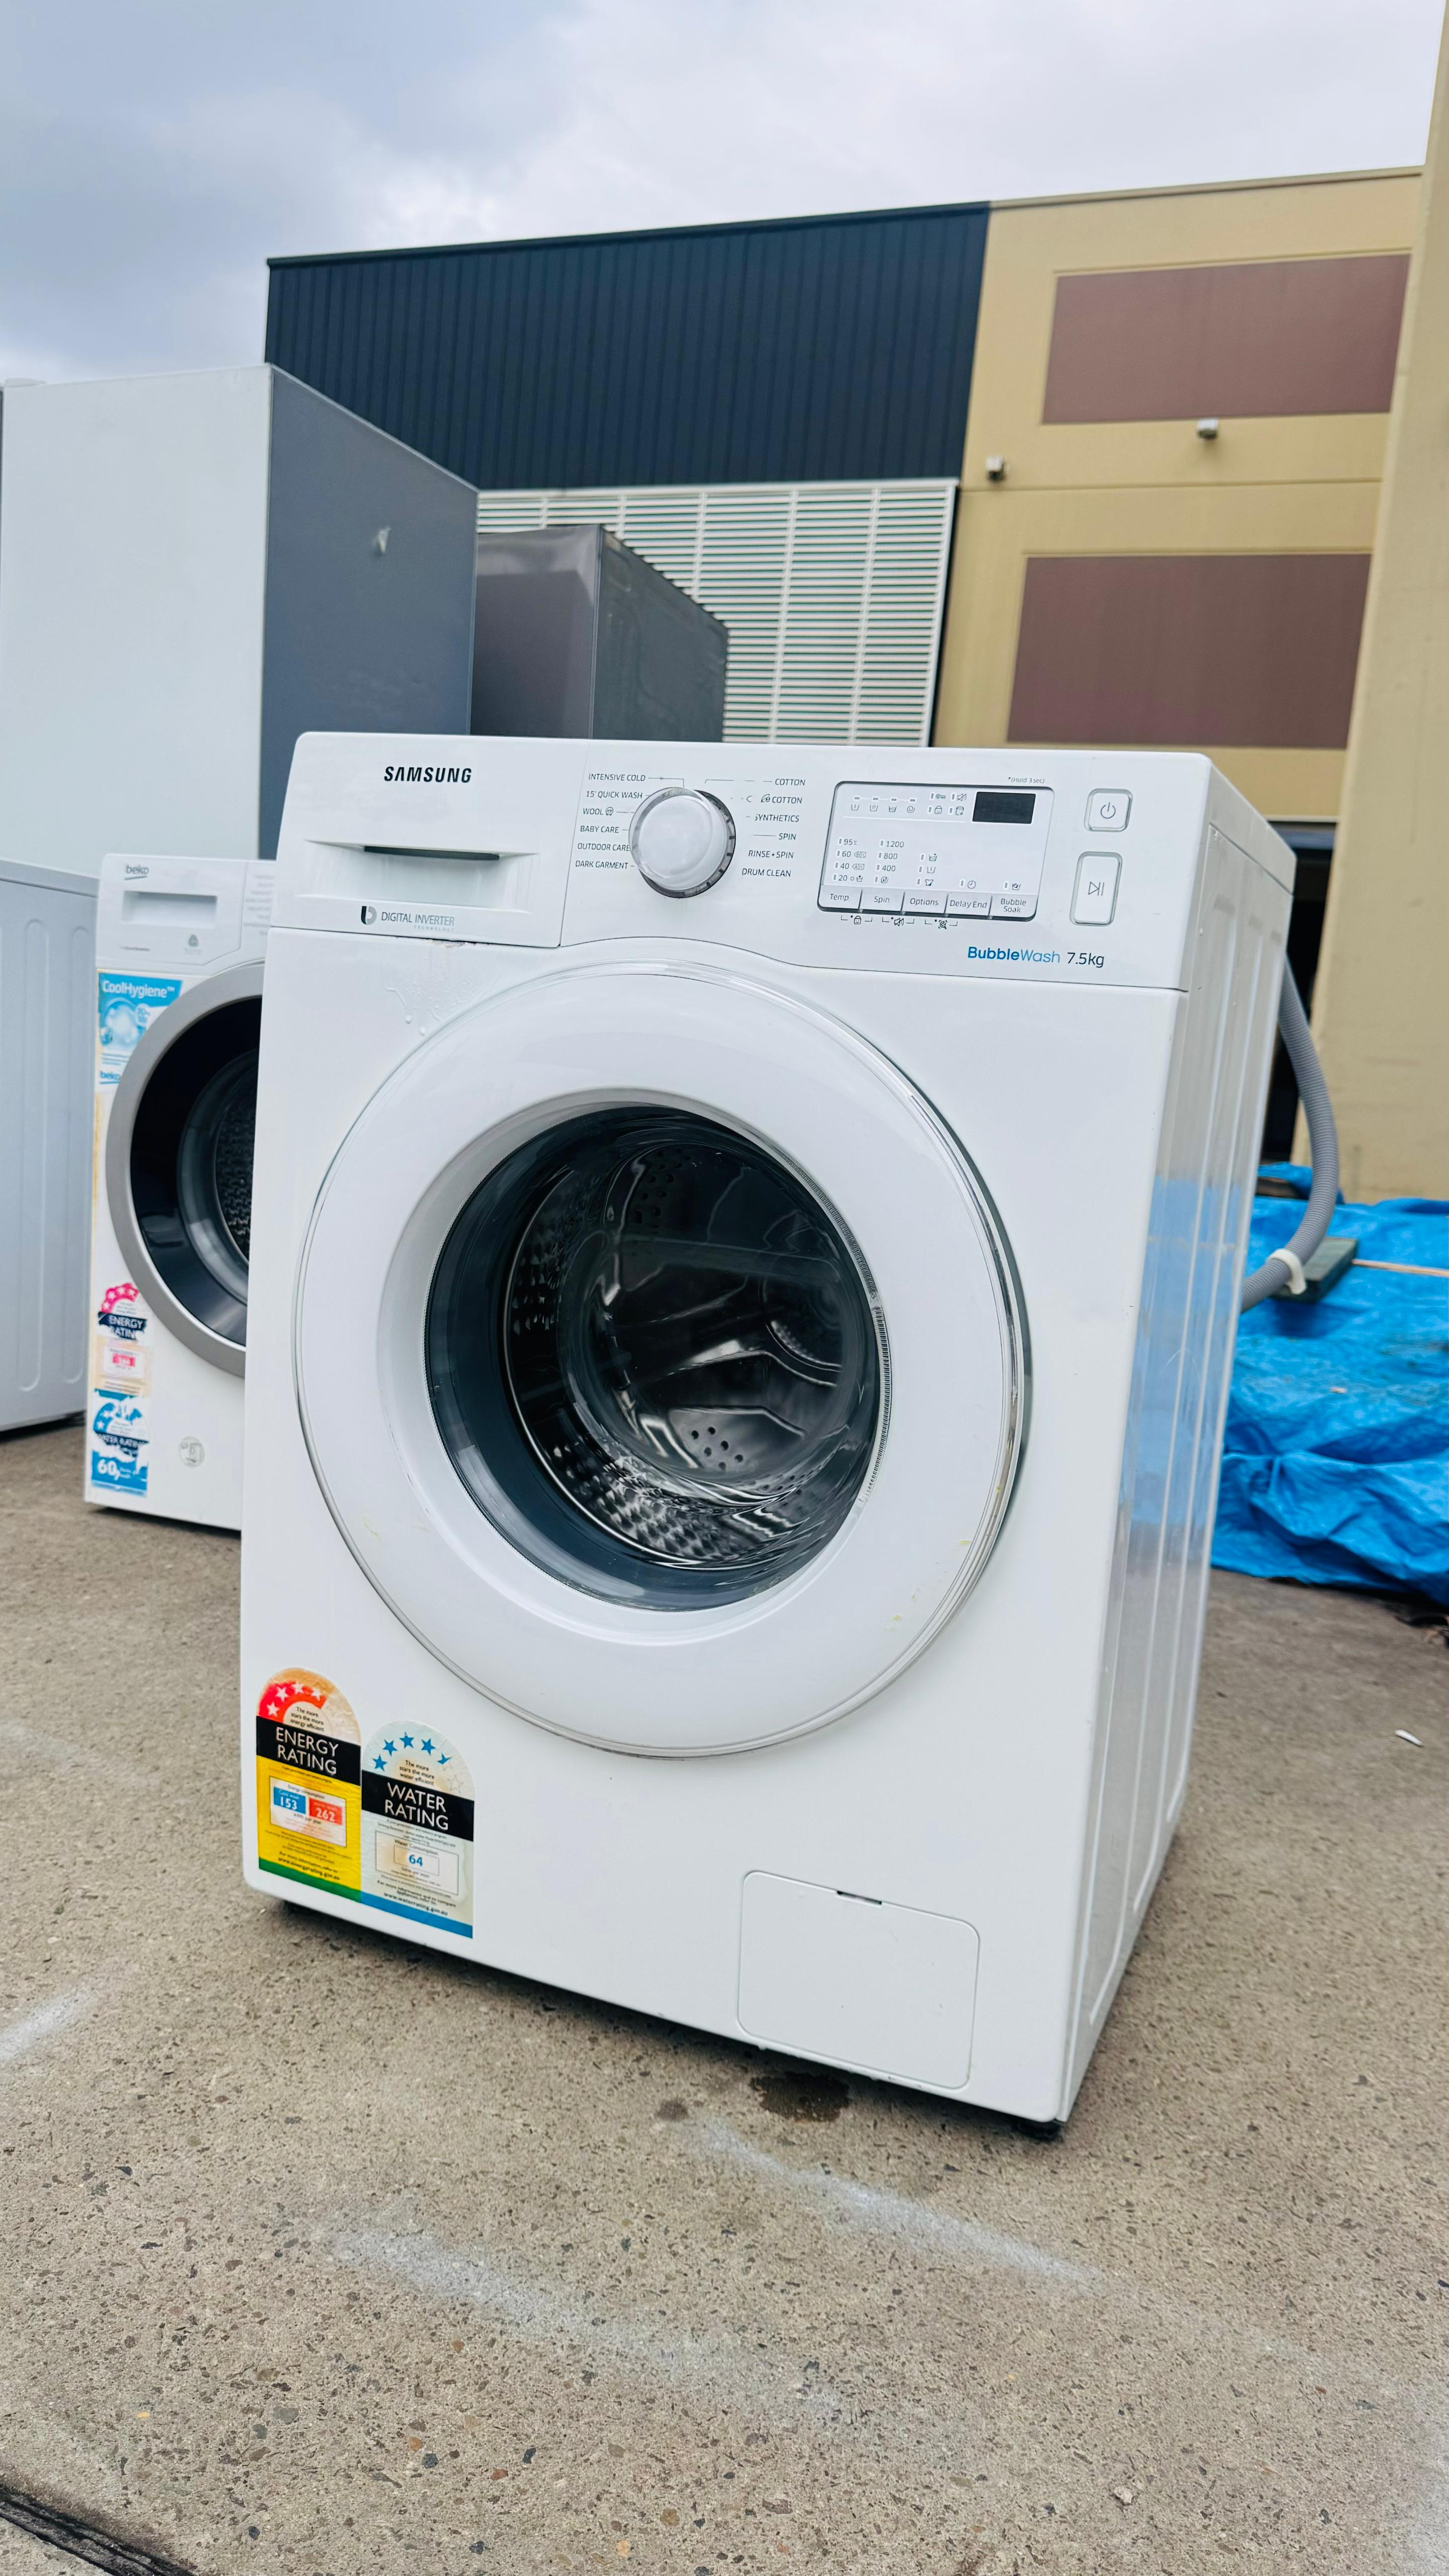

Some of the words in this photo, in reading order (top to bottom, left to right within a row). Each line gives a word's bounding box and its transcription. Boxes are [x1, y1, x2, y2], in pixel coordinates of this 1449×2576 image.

[384, 766, 472, 783] SAMSUNG
[578, 843, 611, 851] OUTDOOR
[612, 844, 630, 852] CARE
[126, 864, 149, 875] beko
[595, 861, 629, 869] GARMENT
[742, 868, 765, 876] DRUM
[766, 869, 791, 877] CLEAN
[874, 896, 890, 904] Spin
[910, 898, 939, 907] Options
[950, 900, 972, 909] Delay
[1000, 898, 1027, 906] Bubble
[381, 912, 413, 923] DIGITAL
[415, 914, 455, 926] INVERTER
[968, 946, 1060, 963] BubbleWash
[1067, 952, 1105, 968] 7.5kg
[109, 1315, 143, 1329] ENERGY
[296, 1706, 305, 1715] The
[290, 1719, 305, 1727] energy
[276, 1726, 339, 1757] ENERGY
[277, 1744, 337, 1776] RATING
[416, 1763, 430, 1772] more
[399, 1773, 414, 1781] water
[415, 1776, 435, 1786] efficient
[421, 1772, 435, 1780] more
[280, 1796, 298, 1811] 153
[387, 1782, 447, 1813] WATER
[315, 1807, 336, 1822] 262
[384, 1799, 449, 1830] RATING
[409, 1854, 423, 1867] 64
